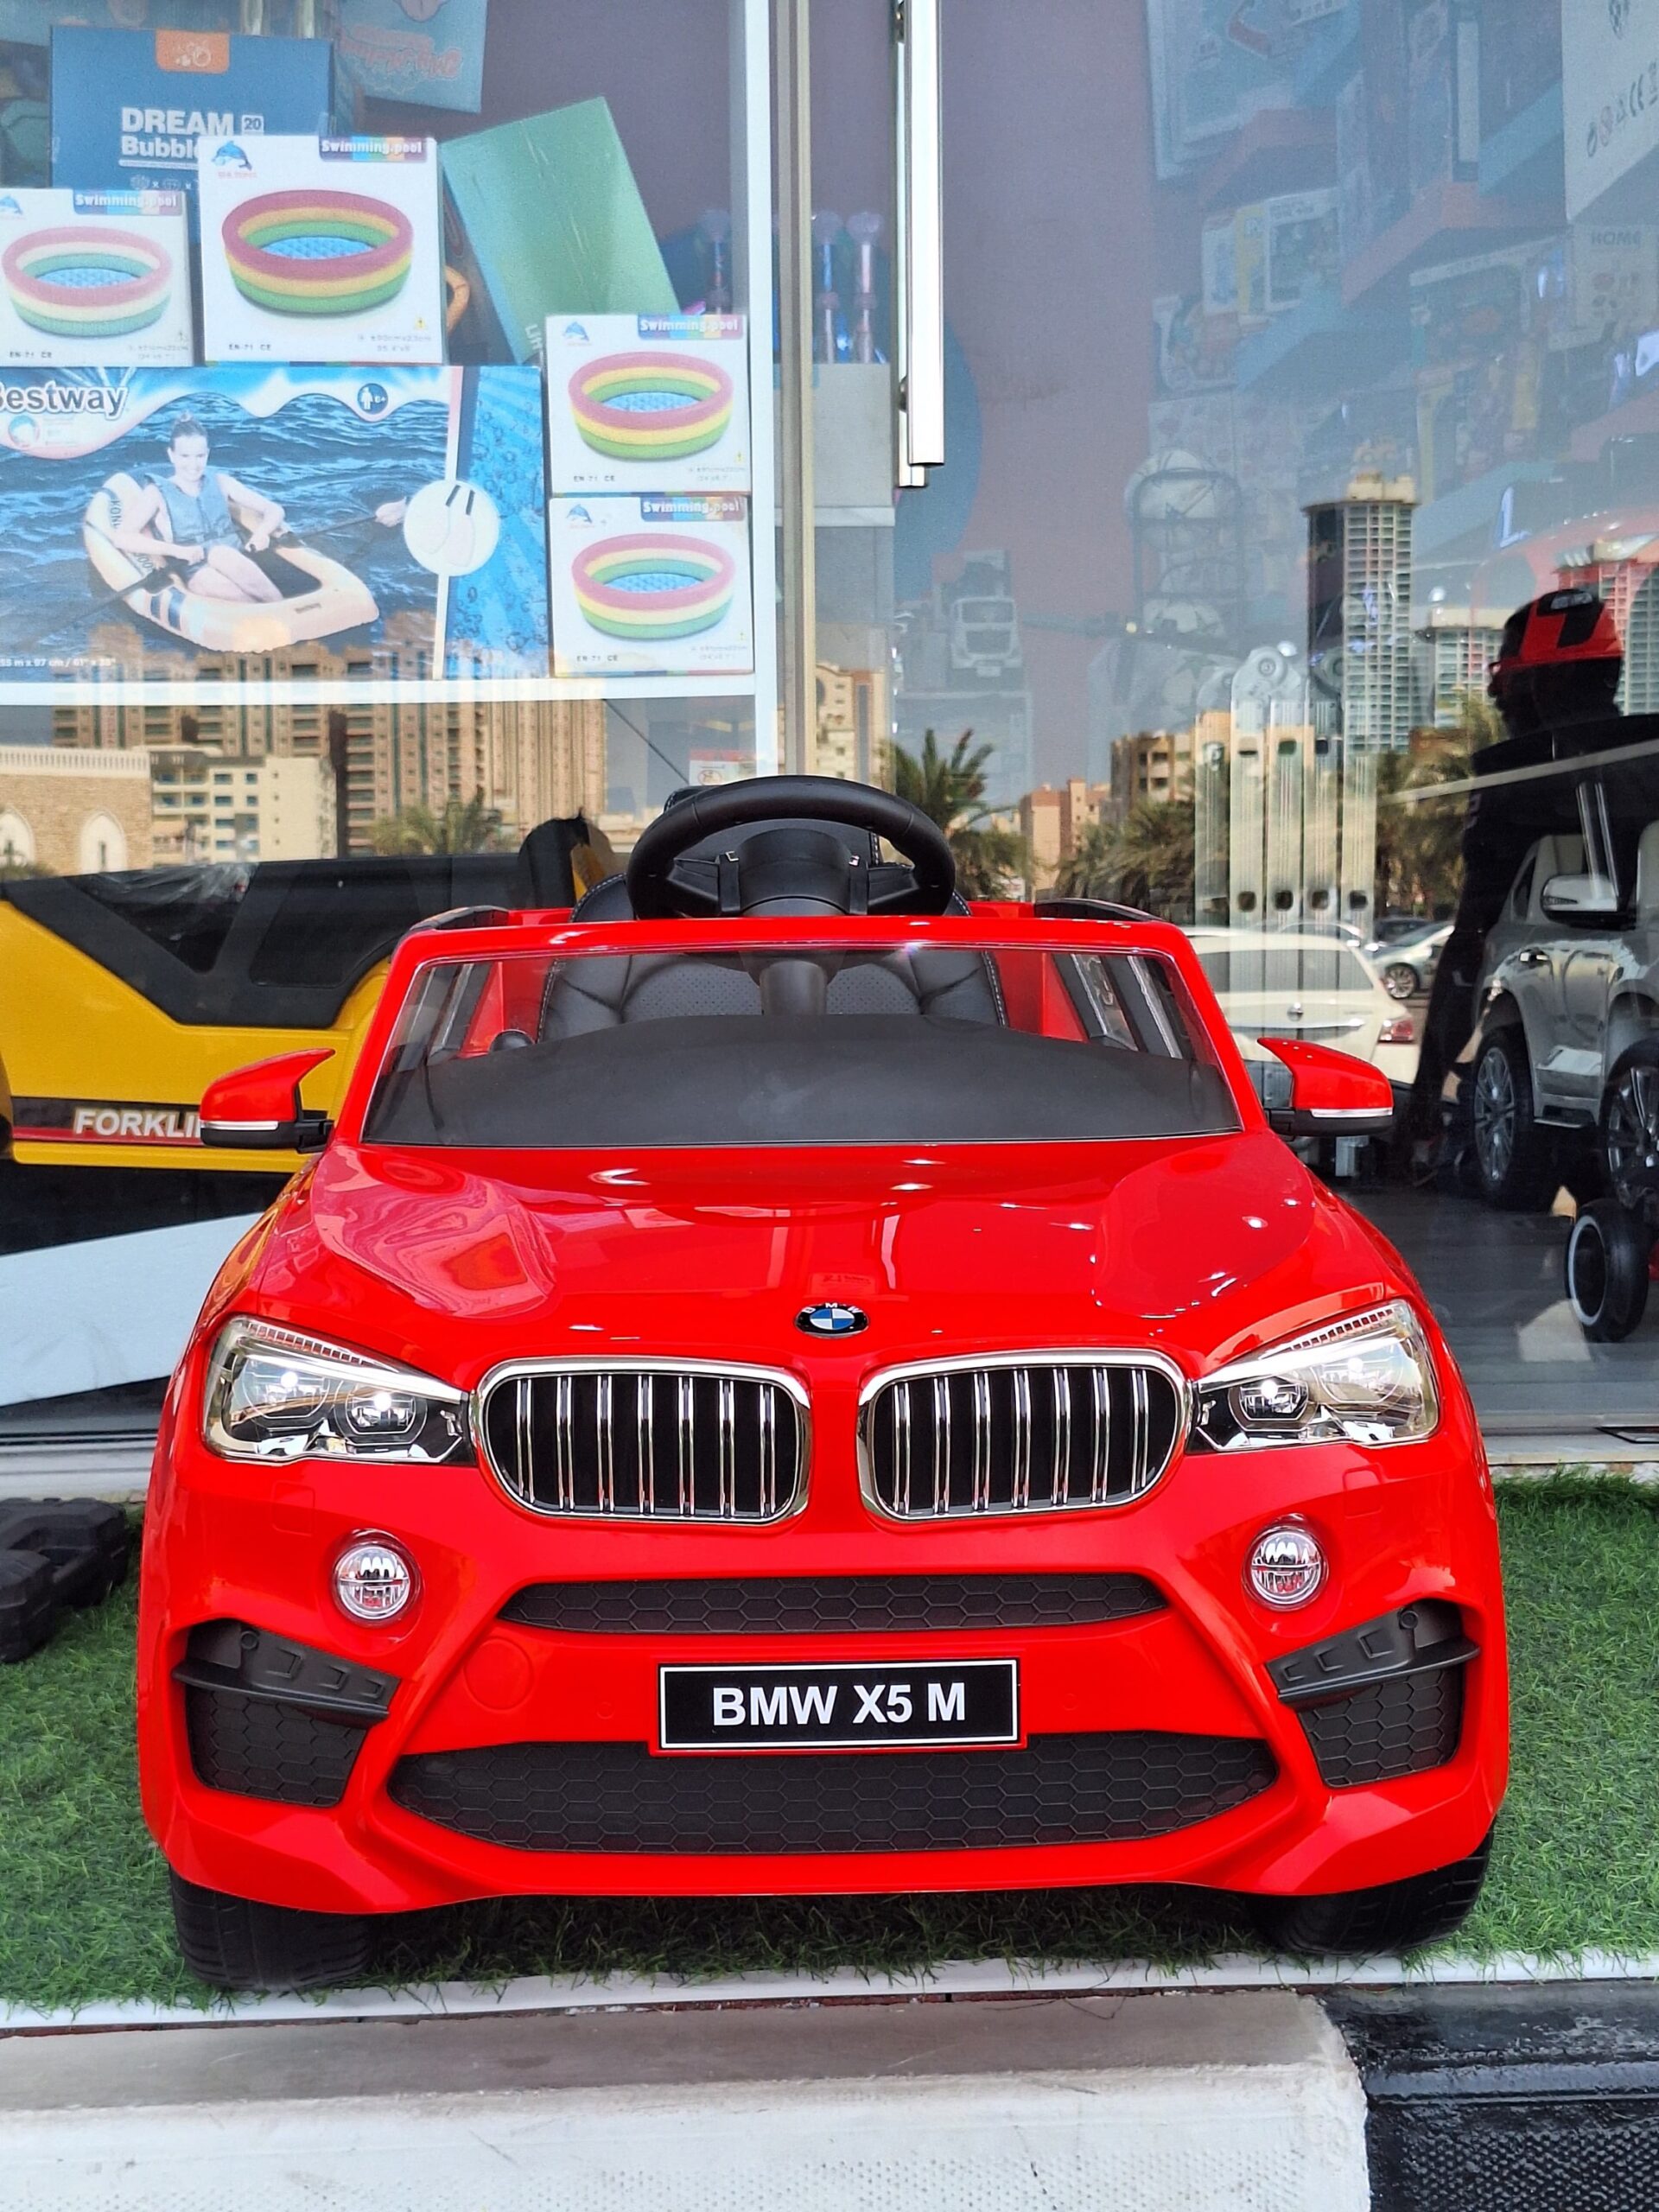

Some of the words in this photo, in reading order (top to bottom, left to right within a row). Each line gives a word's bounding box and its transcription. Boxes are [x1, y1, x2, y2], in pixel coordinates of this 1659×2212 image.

[122, 107, 234, 137] DREAM
[244, 118, 262, 130] 20
[0, 382, 125, 417] estway
[713, 1686, 837, 1726] BMW
[853, 1684, 912, 1724] X5
[928, 1681, 965, 1721] M
